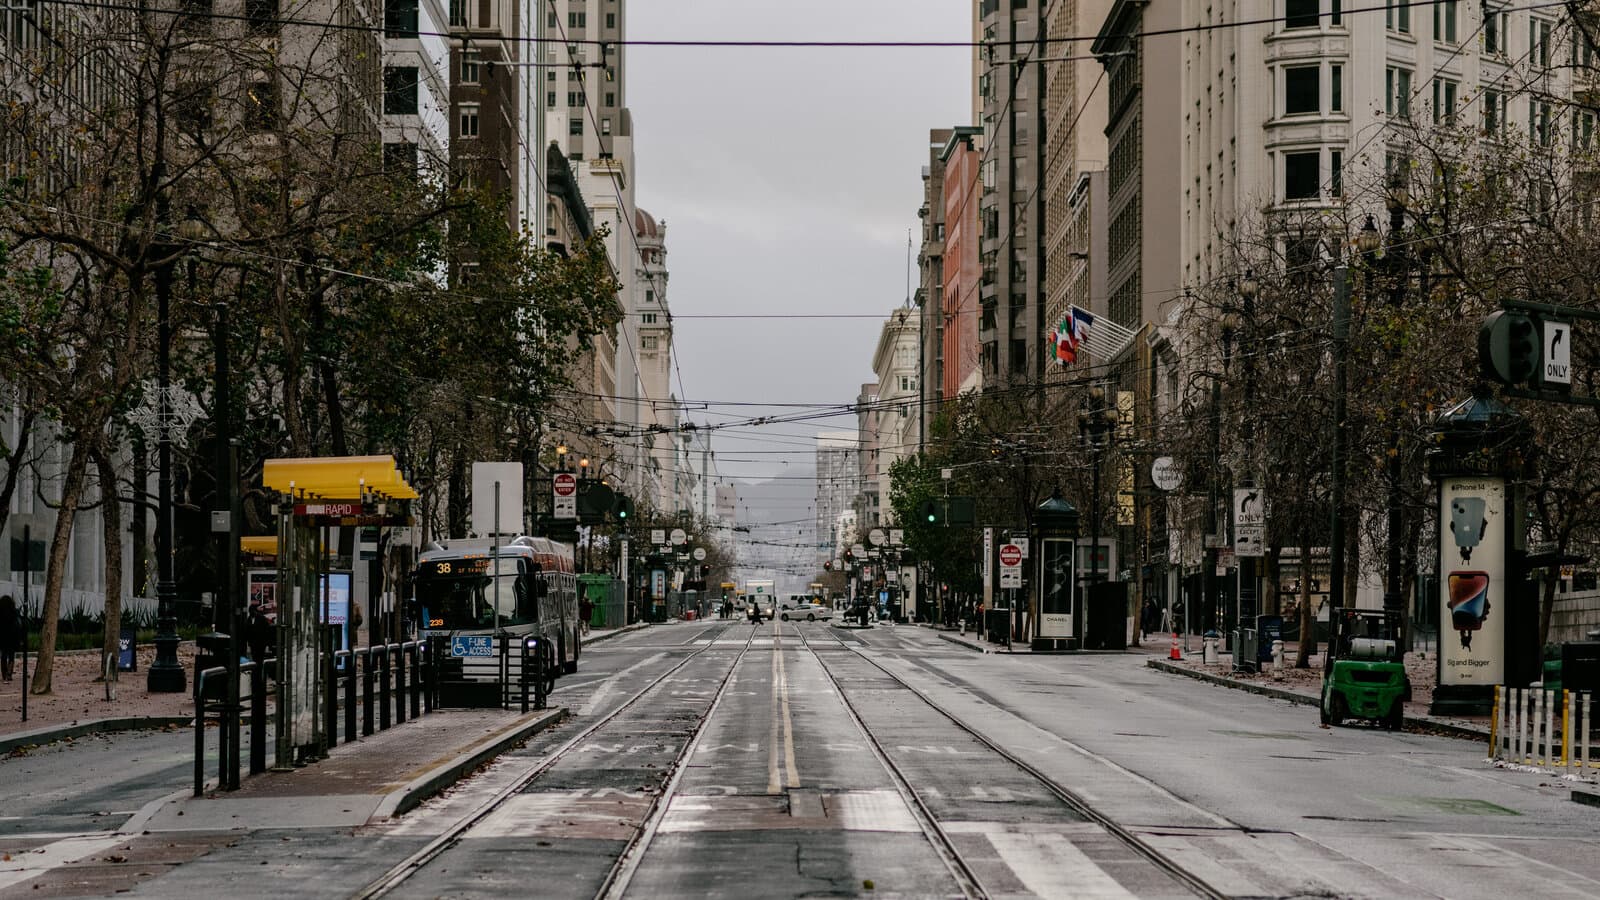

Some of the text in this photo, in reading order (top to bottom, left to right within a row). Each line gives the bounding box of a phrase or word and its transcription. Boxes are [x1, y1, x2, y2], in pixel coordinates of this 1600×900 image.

[1547, 363, 1568, 378] ONLY
[325, 504, 352, 515] RAPID
[1239, 514, 1261, 522] ONLY
[436, 562, 452, 574] 38
[468, 637, 487, 646] F-LINE
[468, 646, 491, 656] ACCESS
[1468, 659, 1490, 667] Bigger
